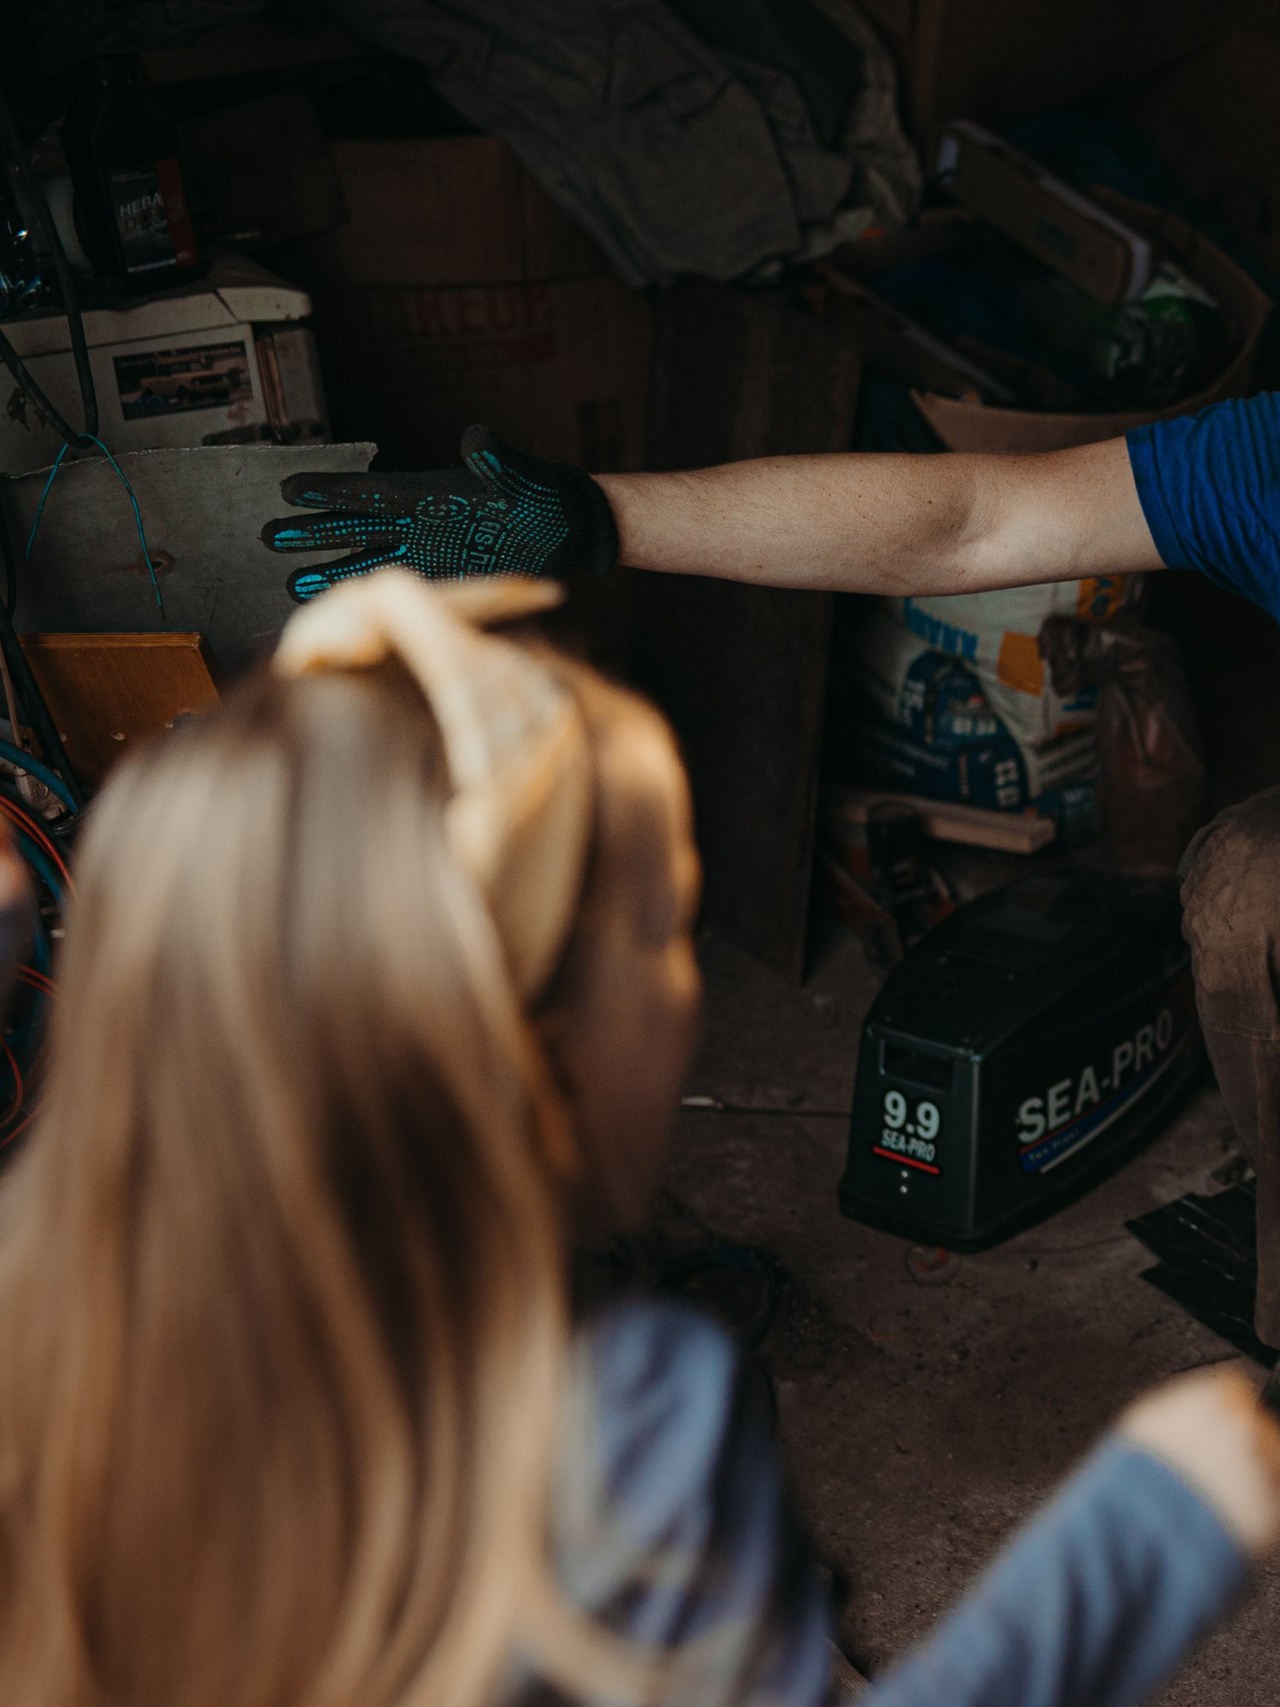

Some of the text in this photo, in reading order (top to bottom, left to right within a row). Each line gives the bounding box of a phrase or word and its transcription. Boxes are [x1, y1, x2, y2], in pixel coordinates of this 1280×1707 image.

[1016, 1008, 1174, 1144] SEA-PRO
[883, 1089, 941, 1140] 9.9
[880, 1129, 937, 1163] SEA-PRO
